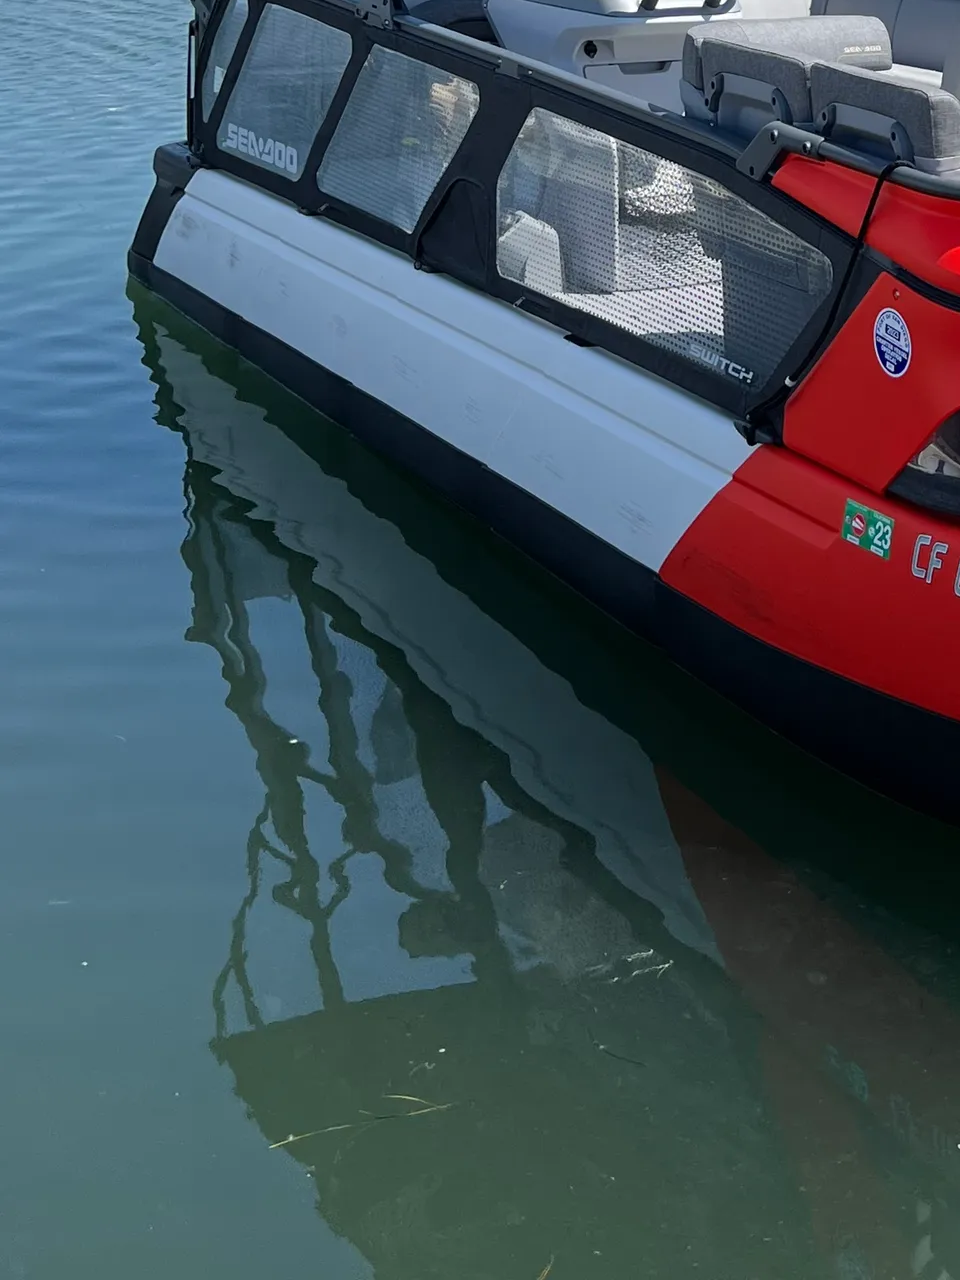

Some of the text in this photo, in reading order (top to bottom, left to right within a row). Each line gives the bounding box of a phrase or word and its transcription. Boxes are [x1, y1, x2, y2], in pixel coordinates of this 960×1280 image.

[689, 343, 754, 384] SWITCH
[873, 521, 892, 550] 23
[911, 533, 949, 584] CF
